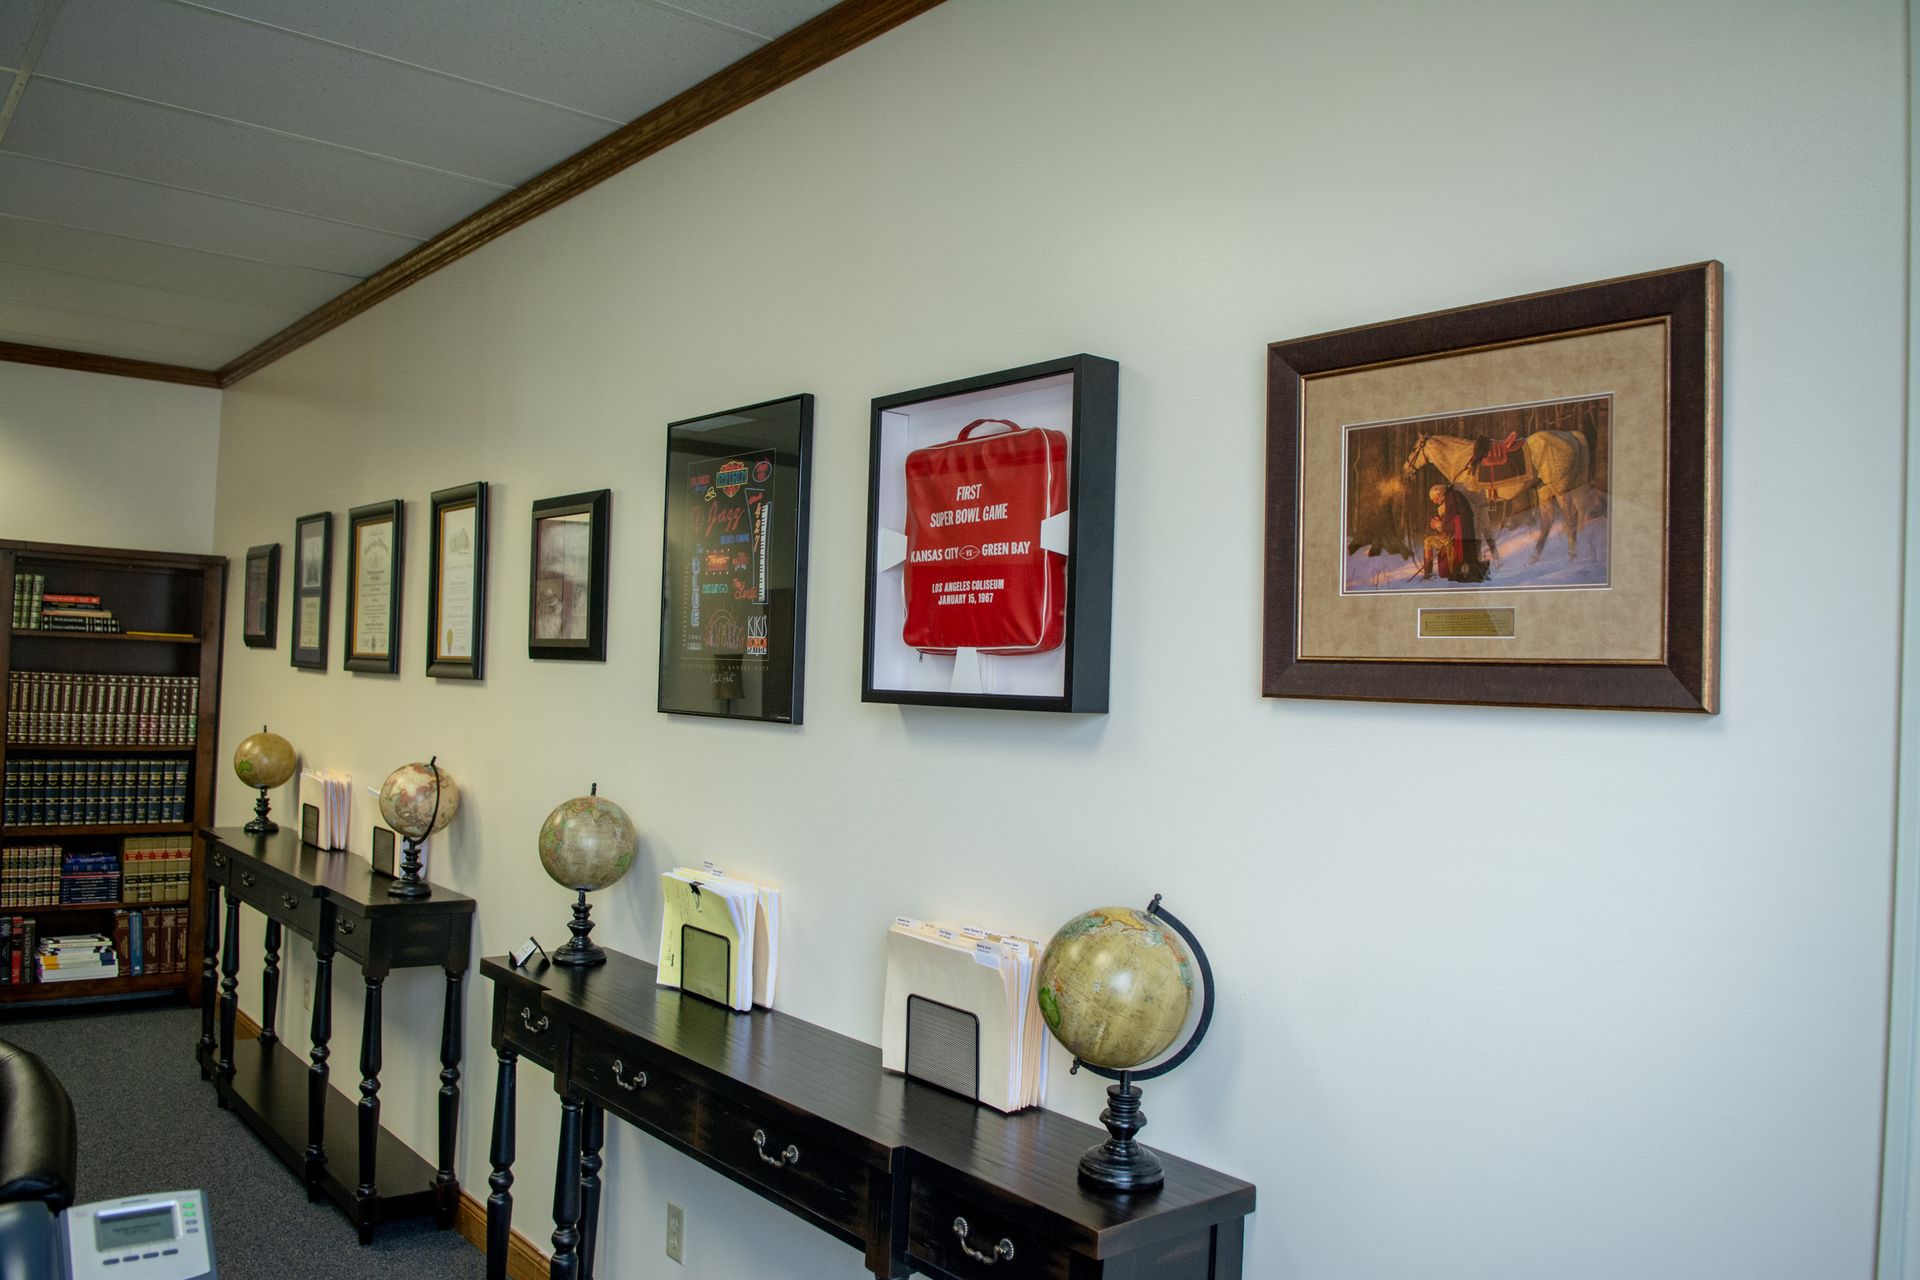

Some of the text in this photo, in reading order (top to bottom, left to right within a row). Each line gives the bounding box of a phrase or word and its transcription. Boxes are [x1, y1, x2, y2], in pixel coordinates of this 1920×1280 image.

[956, 484, 982, 501] FIRST
[929, 503, 1008, 528] SUPER BOWL GAME
[910, 549, 943, 563] KANSAS
[944, 547, 959, 559] CITY
[981, 543, 1009, 556] GREEN
[1011, 541, 1031, 555] BAY
[691, 558, 701, 627] BLUE
[932, 579, 1005, 593] LOS ANGELES COLISEUM
[938, 592, 994, 605] JANUARY 15, 1967
